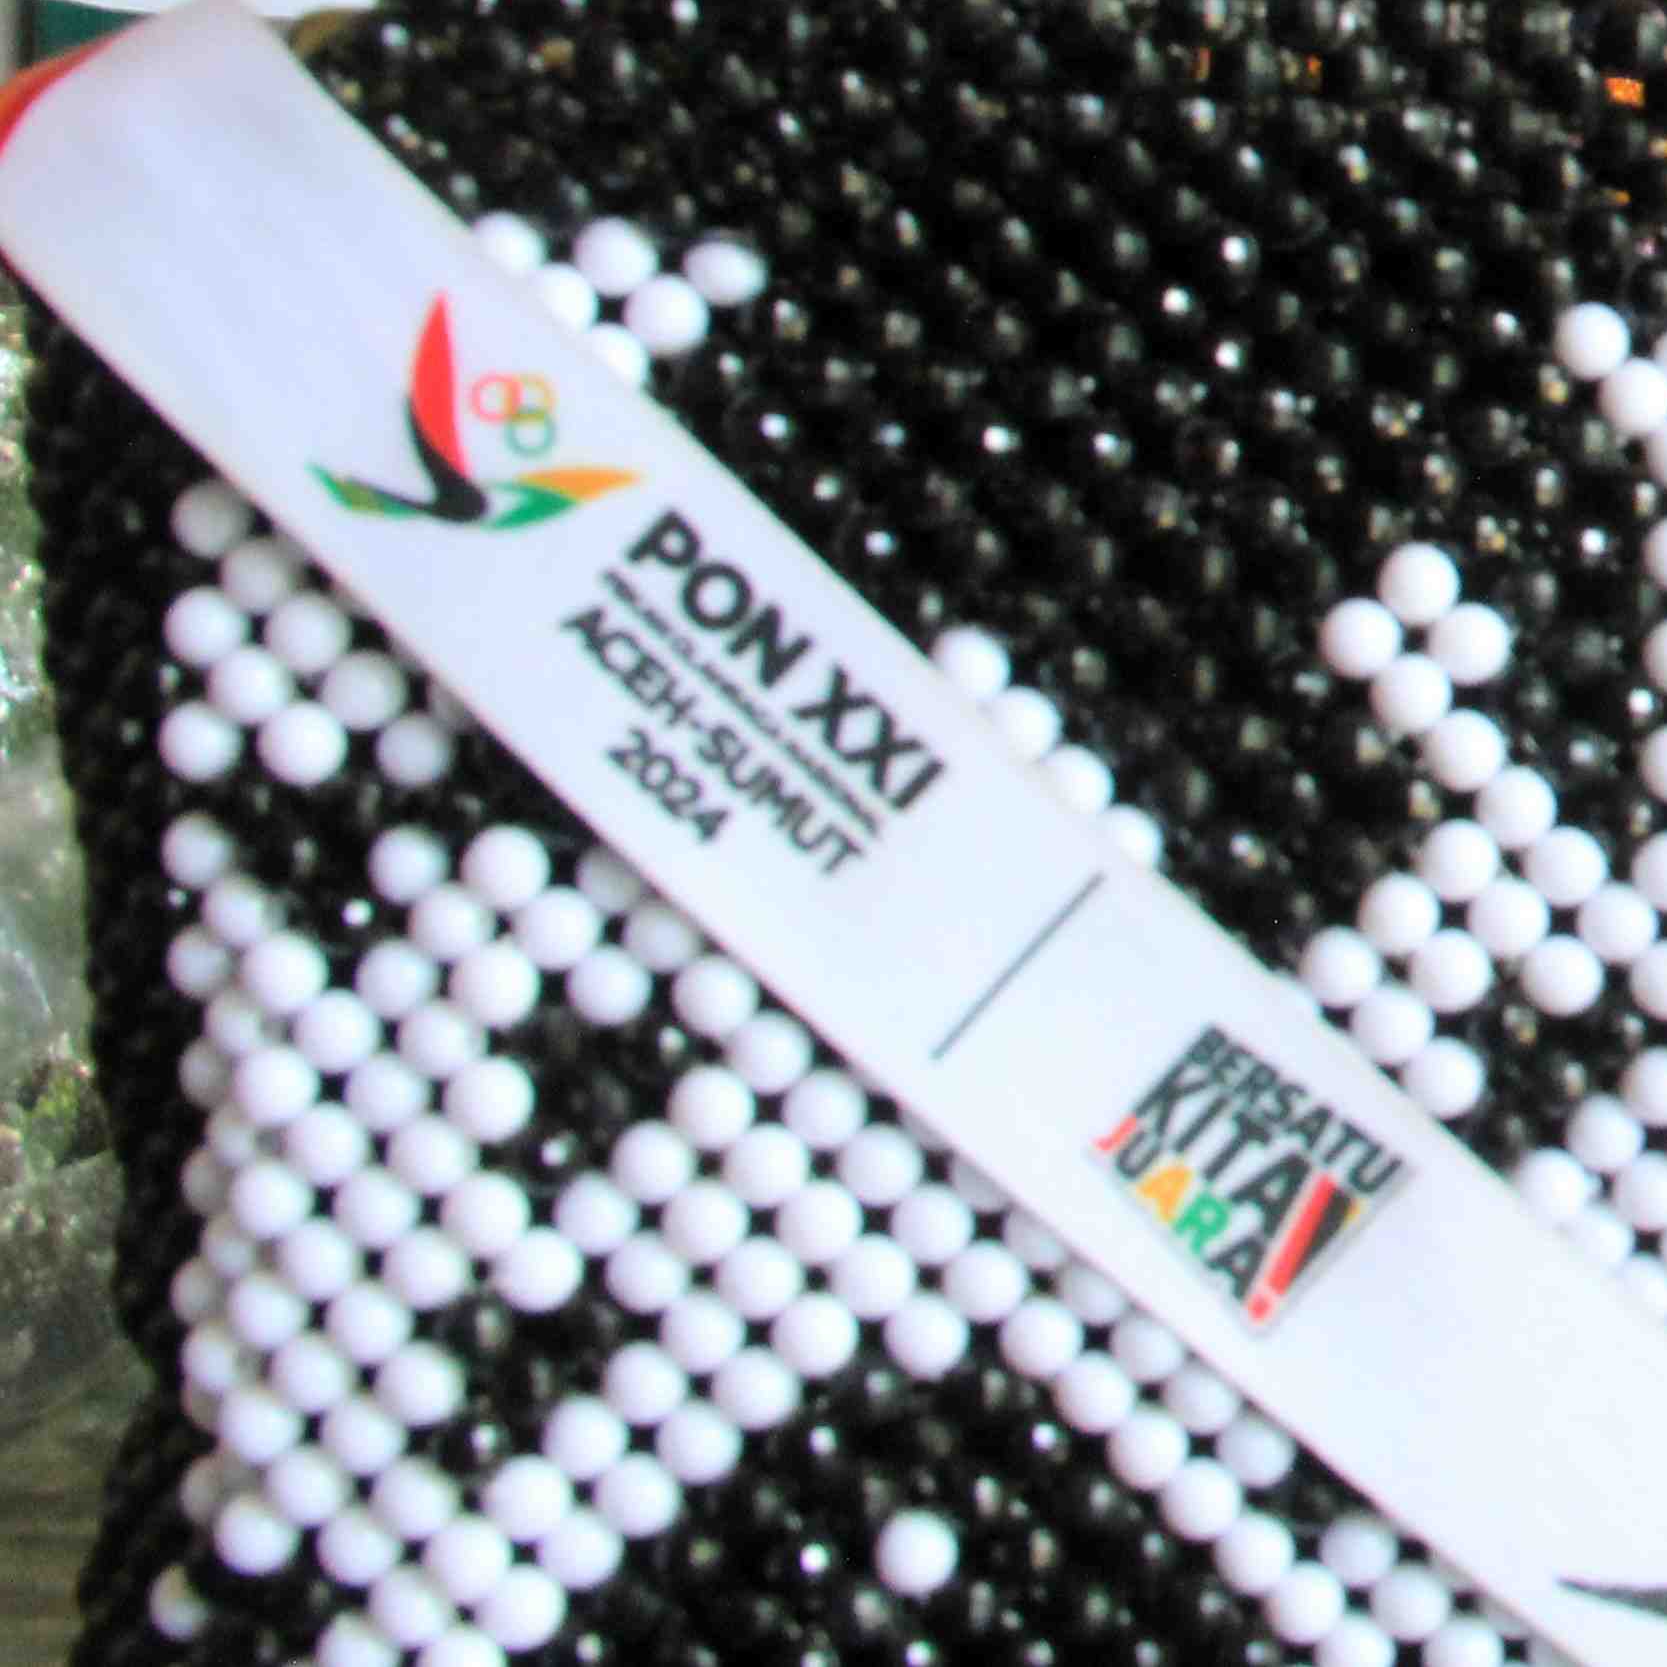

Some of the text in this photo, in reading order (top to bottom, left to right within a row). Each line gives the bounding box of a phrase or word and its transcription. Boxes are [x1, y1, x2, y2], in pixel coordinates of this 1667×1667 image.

[561, 608, 862, 872] ACEH-SUMUT
[627, 511, 811, 687] PON
[793, 667, 943, 809] XXI
[609, 730, 730, 842] 2024
[1187, 1025, 1403, 1195] BERSATU
